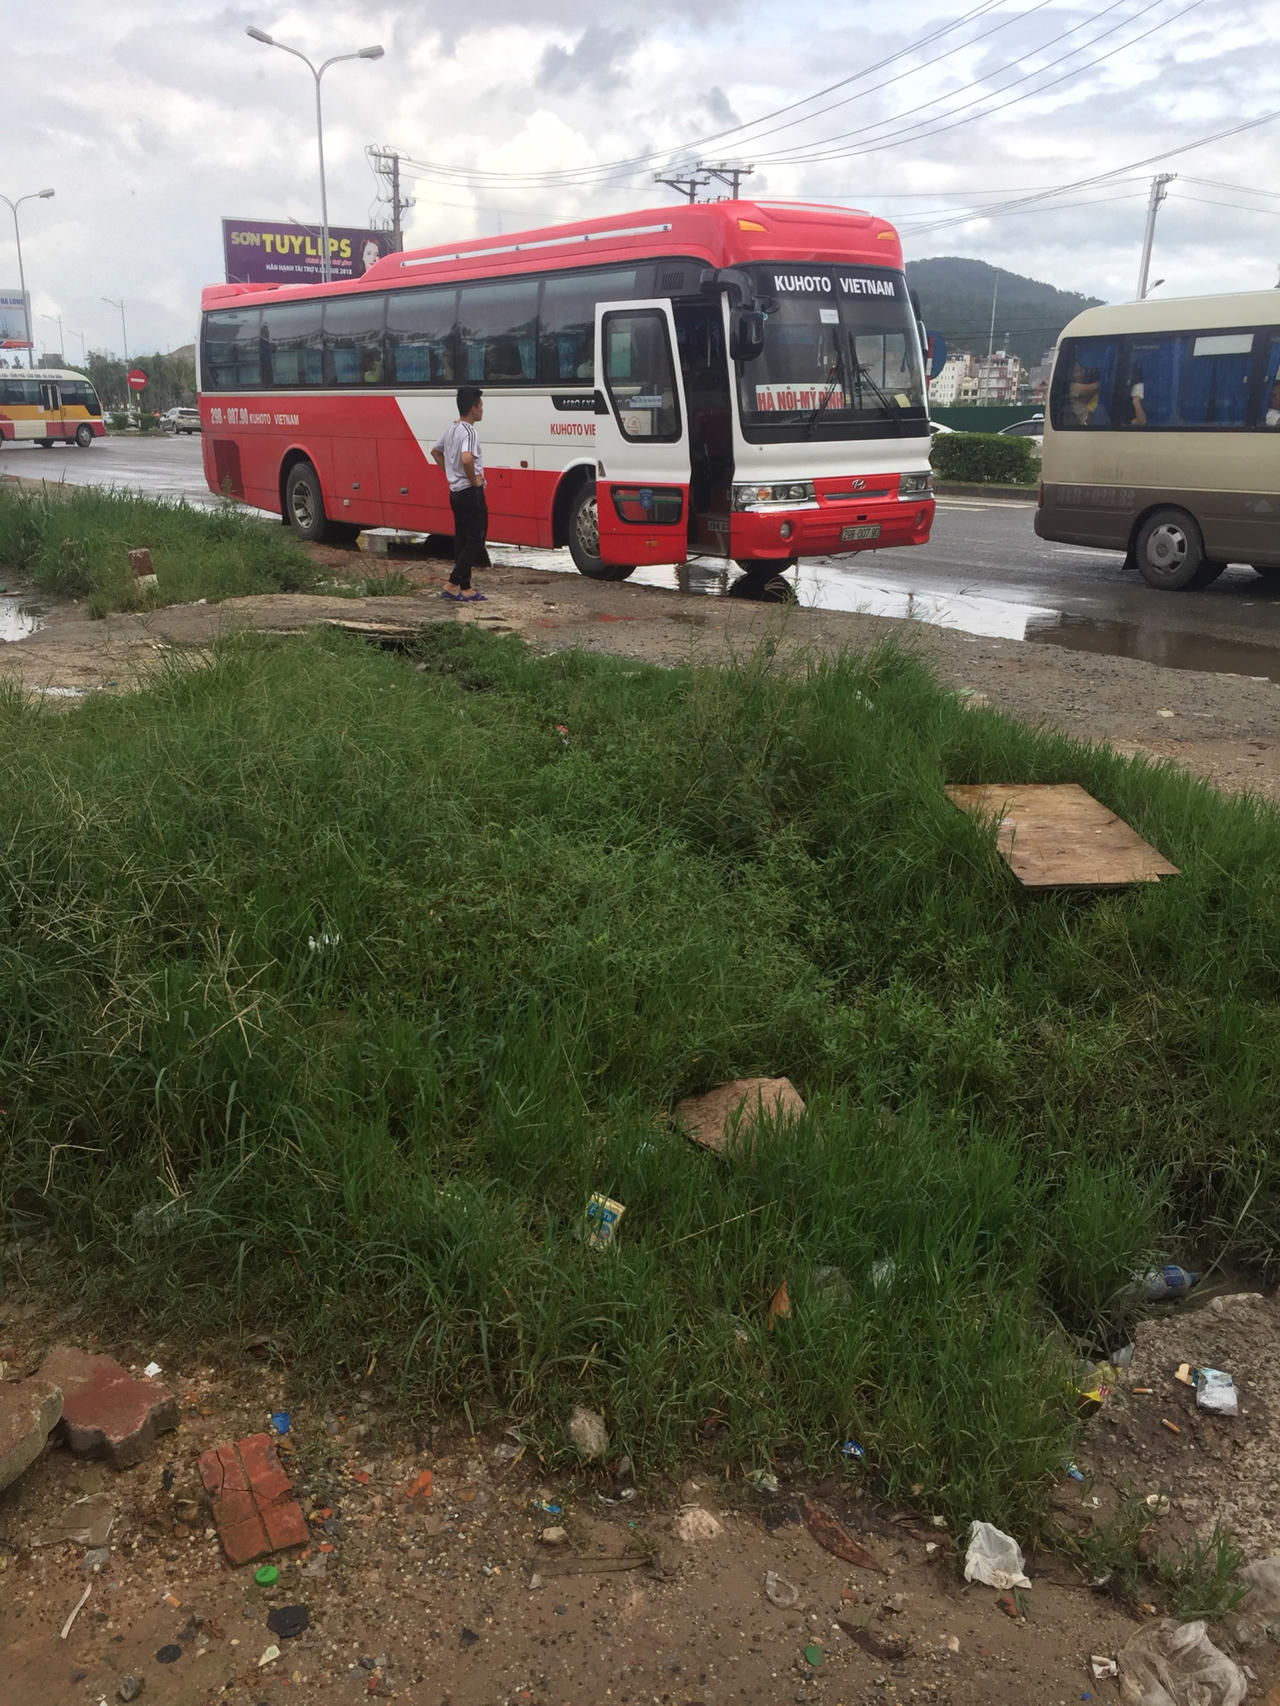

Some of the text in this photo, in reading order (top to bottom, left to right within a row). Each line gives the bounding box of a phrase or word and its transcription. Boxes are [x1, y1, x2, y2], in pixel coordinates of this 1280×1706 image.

[231, 231, 352, 258] SƠN TUYLIPS
[774, 275, 895, 297] KUHOTO VIETNAM
[757, 386, 776, 411] HÀ
[249, 413, 299, 425] KUHOTO VIETNAM
[550, 423, 596, 436] KUHOTO VIE
